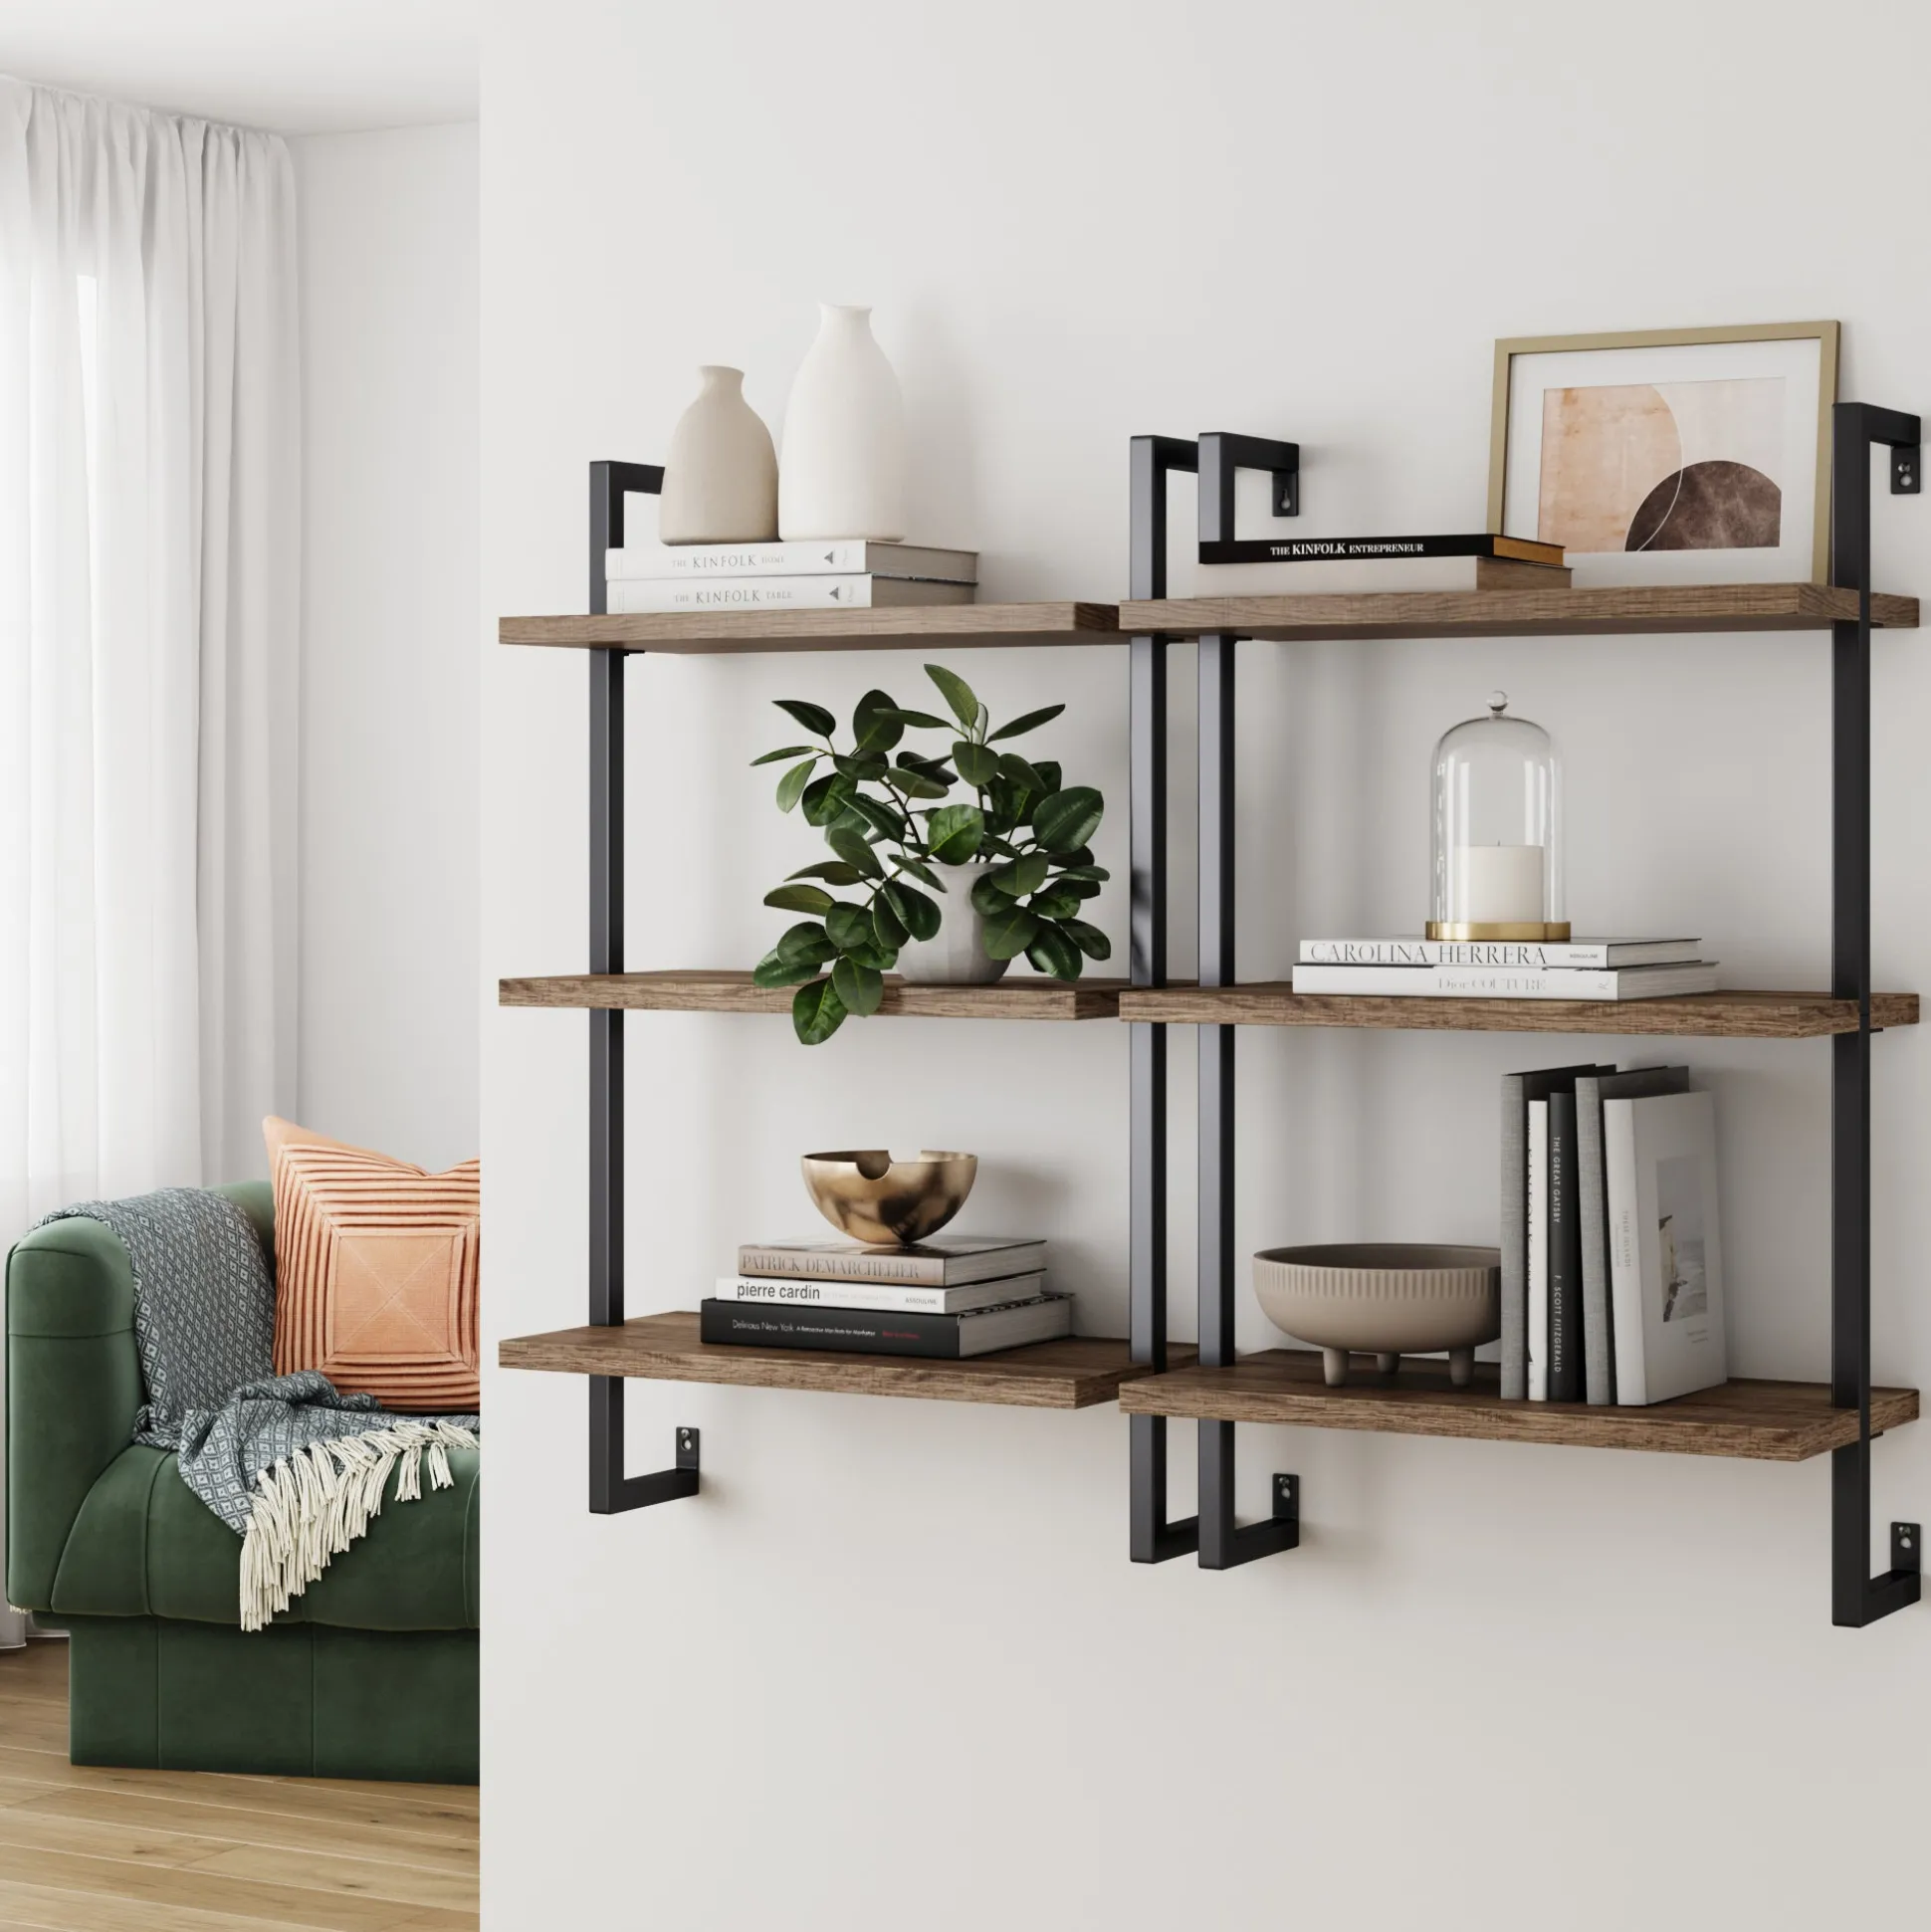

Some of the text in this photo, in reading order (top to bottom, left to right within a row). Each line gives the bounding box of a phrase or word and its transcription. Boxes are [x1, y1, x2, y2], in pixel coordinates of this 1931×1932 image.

[1270, 542, 1424, 556] THE KINFOLK ENTREPRENEUR
[671, 559, 687, 568] THE
[692, 553, 756, 568] KINFOLK
[674, 594, 690, 603] THE
[696, 589, 760, 604] KINFOLK
[1311, 943, 1428, 963] CAROLINA
[1439, 945, 1548, 965] HERRERA
[1553, 1188, 1562, 1223] GATSBY
[743, 1253, 920, 1279] PATRICK DEMARCHELIER
[737, 1282, 775, 1300] pierre
[778, 1283, 820, 1300] cardin
[760, 1321, 778, 1332] New
[779, 1322, 794, 1332] York
